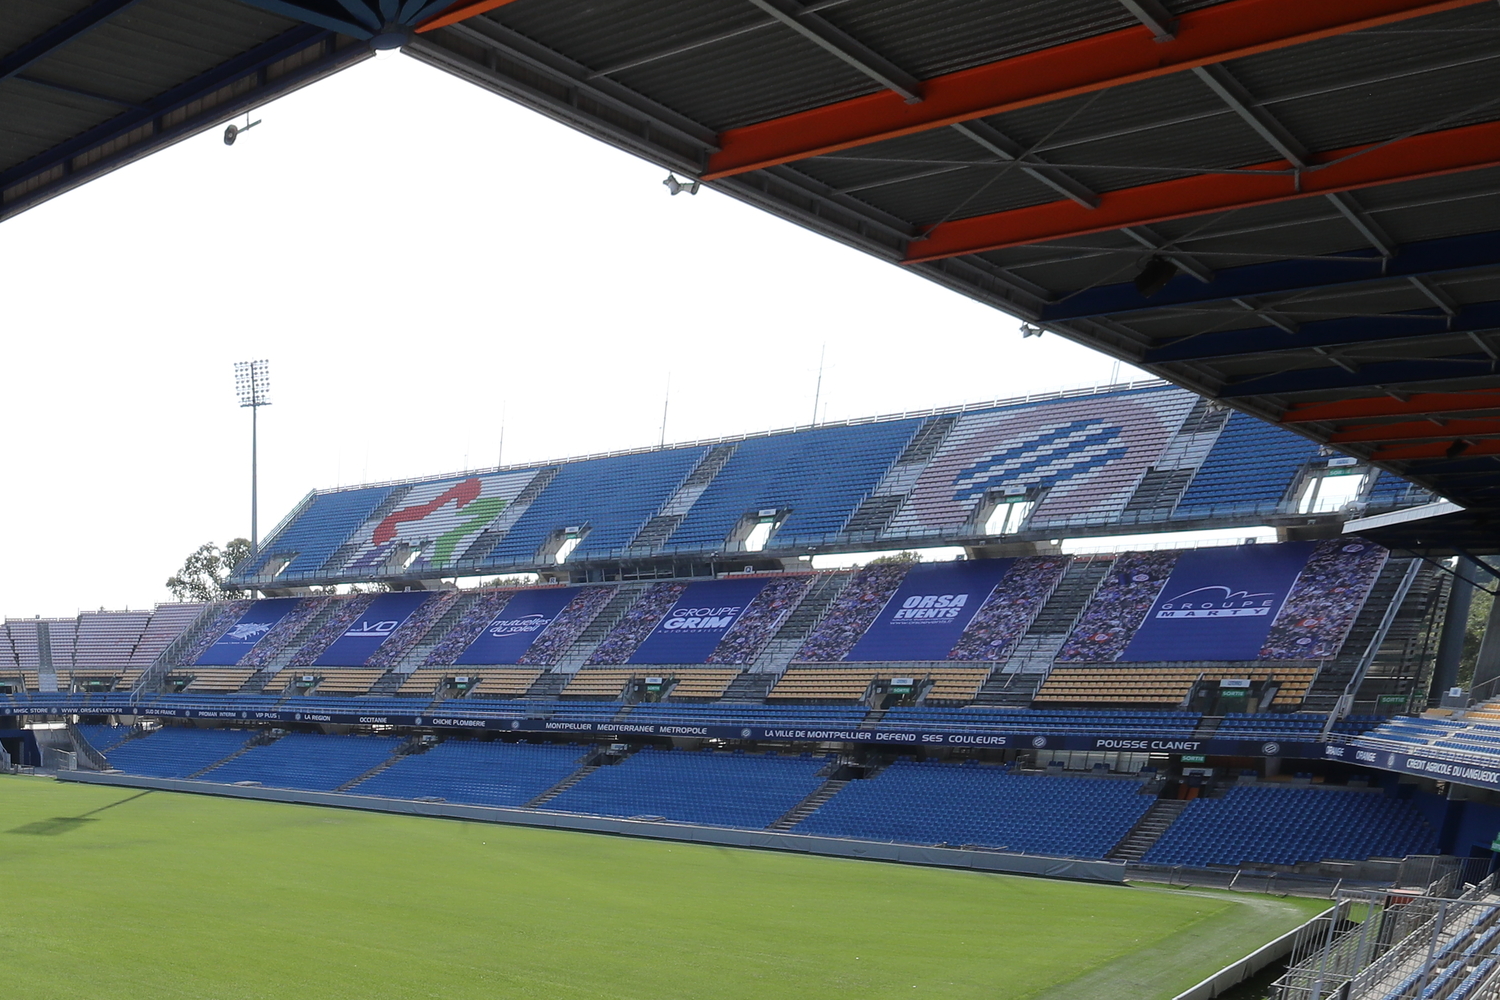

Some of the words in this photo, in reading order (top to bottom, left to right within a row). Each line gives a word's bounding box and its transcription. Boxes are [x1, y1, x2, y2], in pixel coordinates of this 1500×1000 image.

[902, 594, 968, 608] ORSA
[1161, 600, 1273, 610] GROUPE
[672, 606, 740, 617] GROUPE
[894, 608, 962, 618] EVENTS
[491, 618, 552, 626] mutuelles
[664, 616, 733, 630] GRIM
[546, 722, 592, 730] MONTPELLIER
[596, 724, 654, 732] MEDITERRANEE
[660, 726, 707, 734] METROPOLE
[764, 730, 774, 738] LA
[775, 730, 794, 738] VILLE
[806, 731, 872, 740] MONTPELLIER
[876, 732, 916, 742] DEFEND
[922, 734, 943, 742] SES
[948, 735, 1006, 745] COULEURS
[1096, 740, 1148, 749] POUSSE
[1151, 740, 1200, 750] CLANET
[1326, 746, 1344, 756] ORANGE
[1356, 750, 1376, 762] ORANGE
[1406, 758, 1426, 770] CREDIT
[1426, 762, 1452, 775] AGRICOLE
[1452, 767, 1461, 777] DU
[1462, 767, 1499, 784] LANGUEDOC
